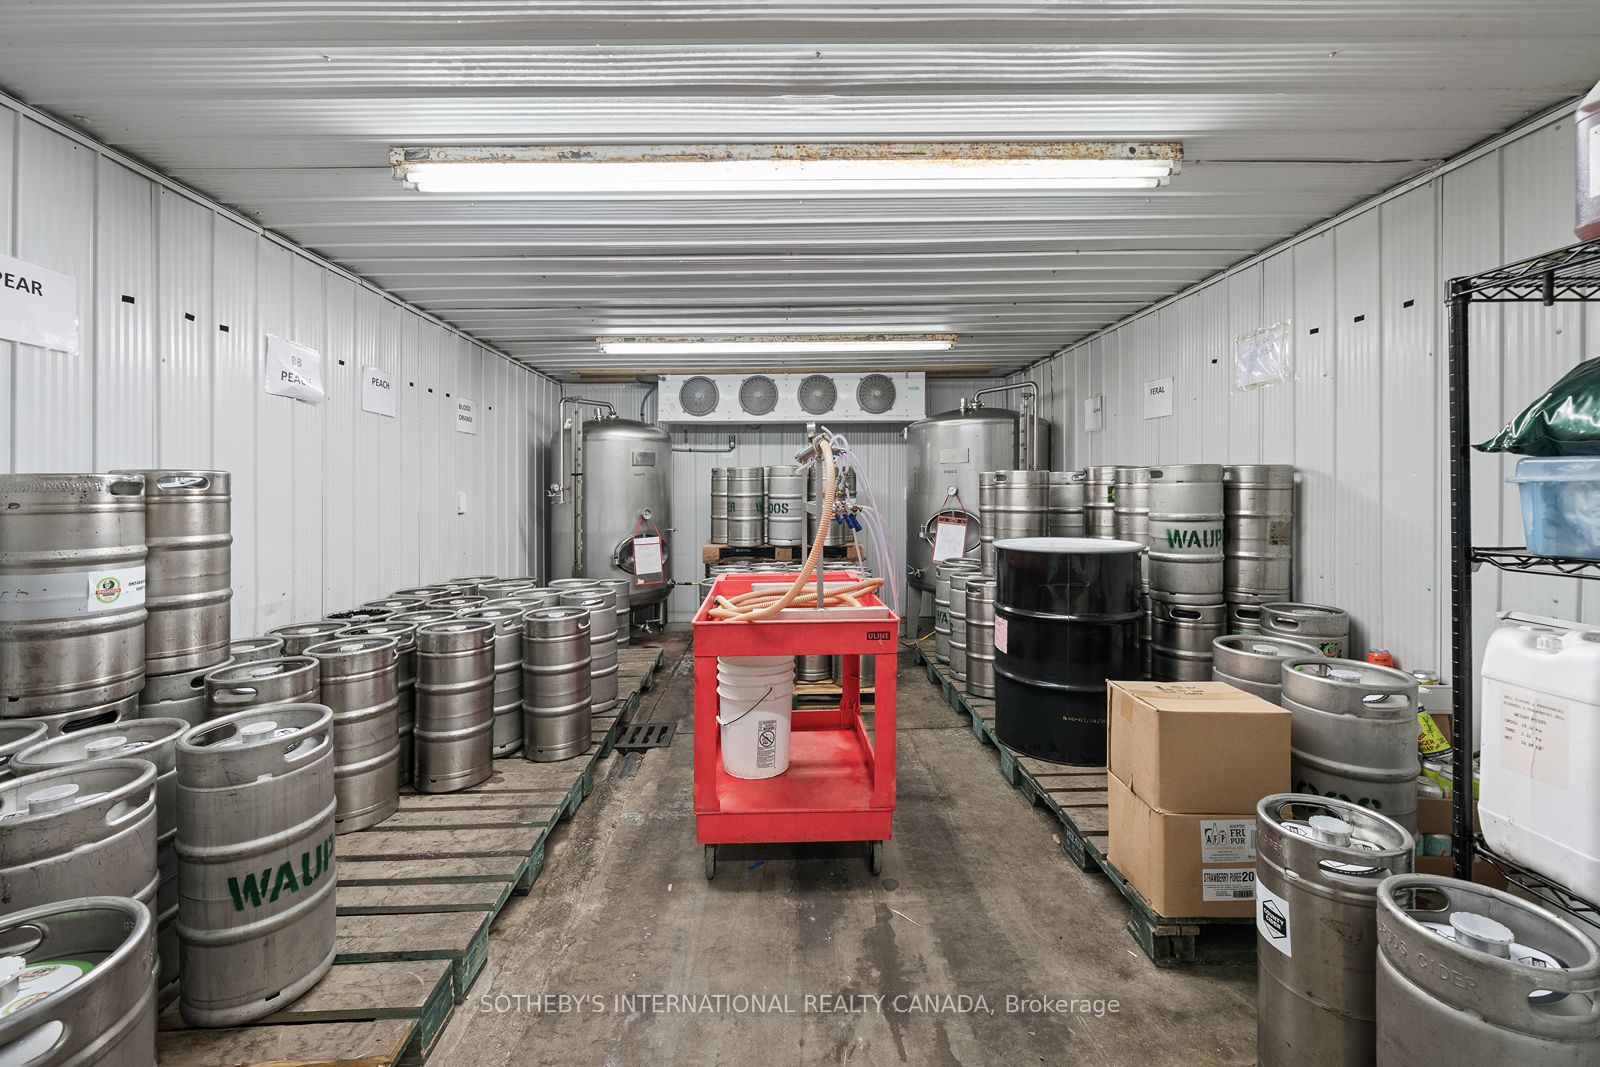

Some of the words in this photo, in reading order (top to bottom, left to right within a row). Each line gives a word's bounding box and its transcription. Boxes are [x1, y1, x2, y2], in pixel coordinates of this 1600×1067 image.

[0, 272, 43, 297] EAR
[291, 355, 302, 368] BB
[371, 377, 391, 390] PEACH
[1150, 386, 1165, 396] FERAL
[458, 403, 471, 412] BLOOD
[458, 414, 473, 423] ORANGE
[867, 632, 890, 640] ULINE
[1204, 873, 1229, 882] STRAWBERRY
[1229, 873, 1241, 882] PUREE
[1242, 871, 1255, 882] 20
[1263, 907, 1285, 926] COUNTY
[1265, 914, 1282, 930] CIDER
[1417, 952, 1478, 991] CIDER
